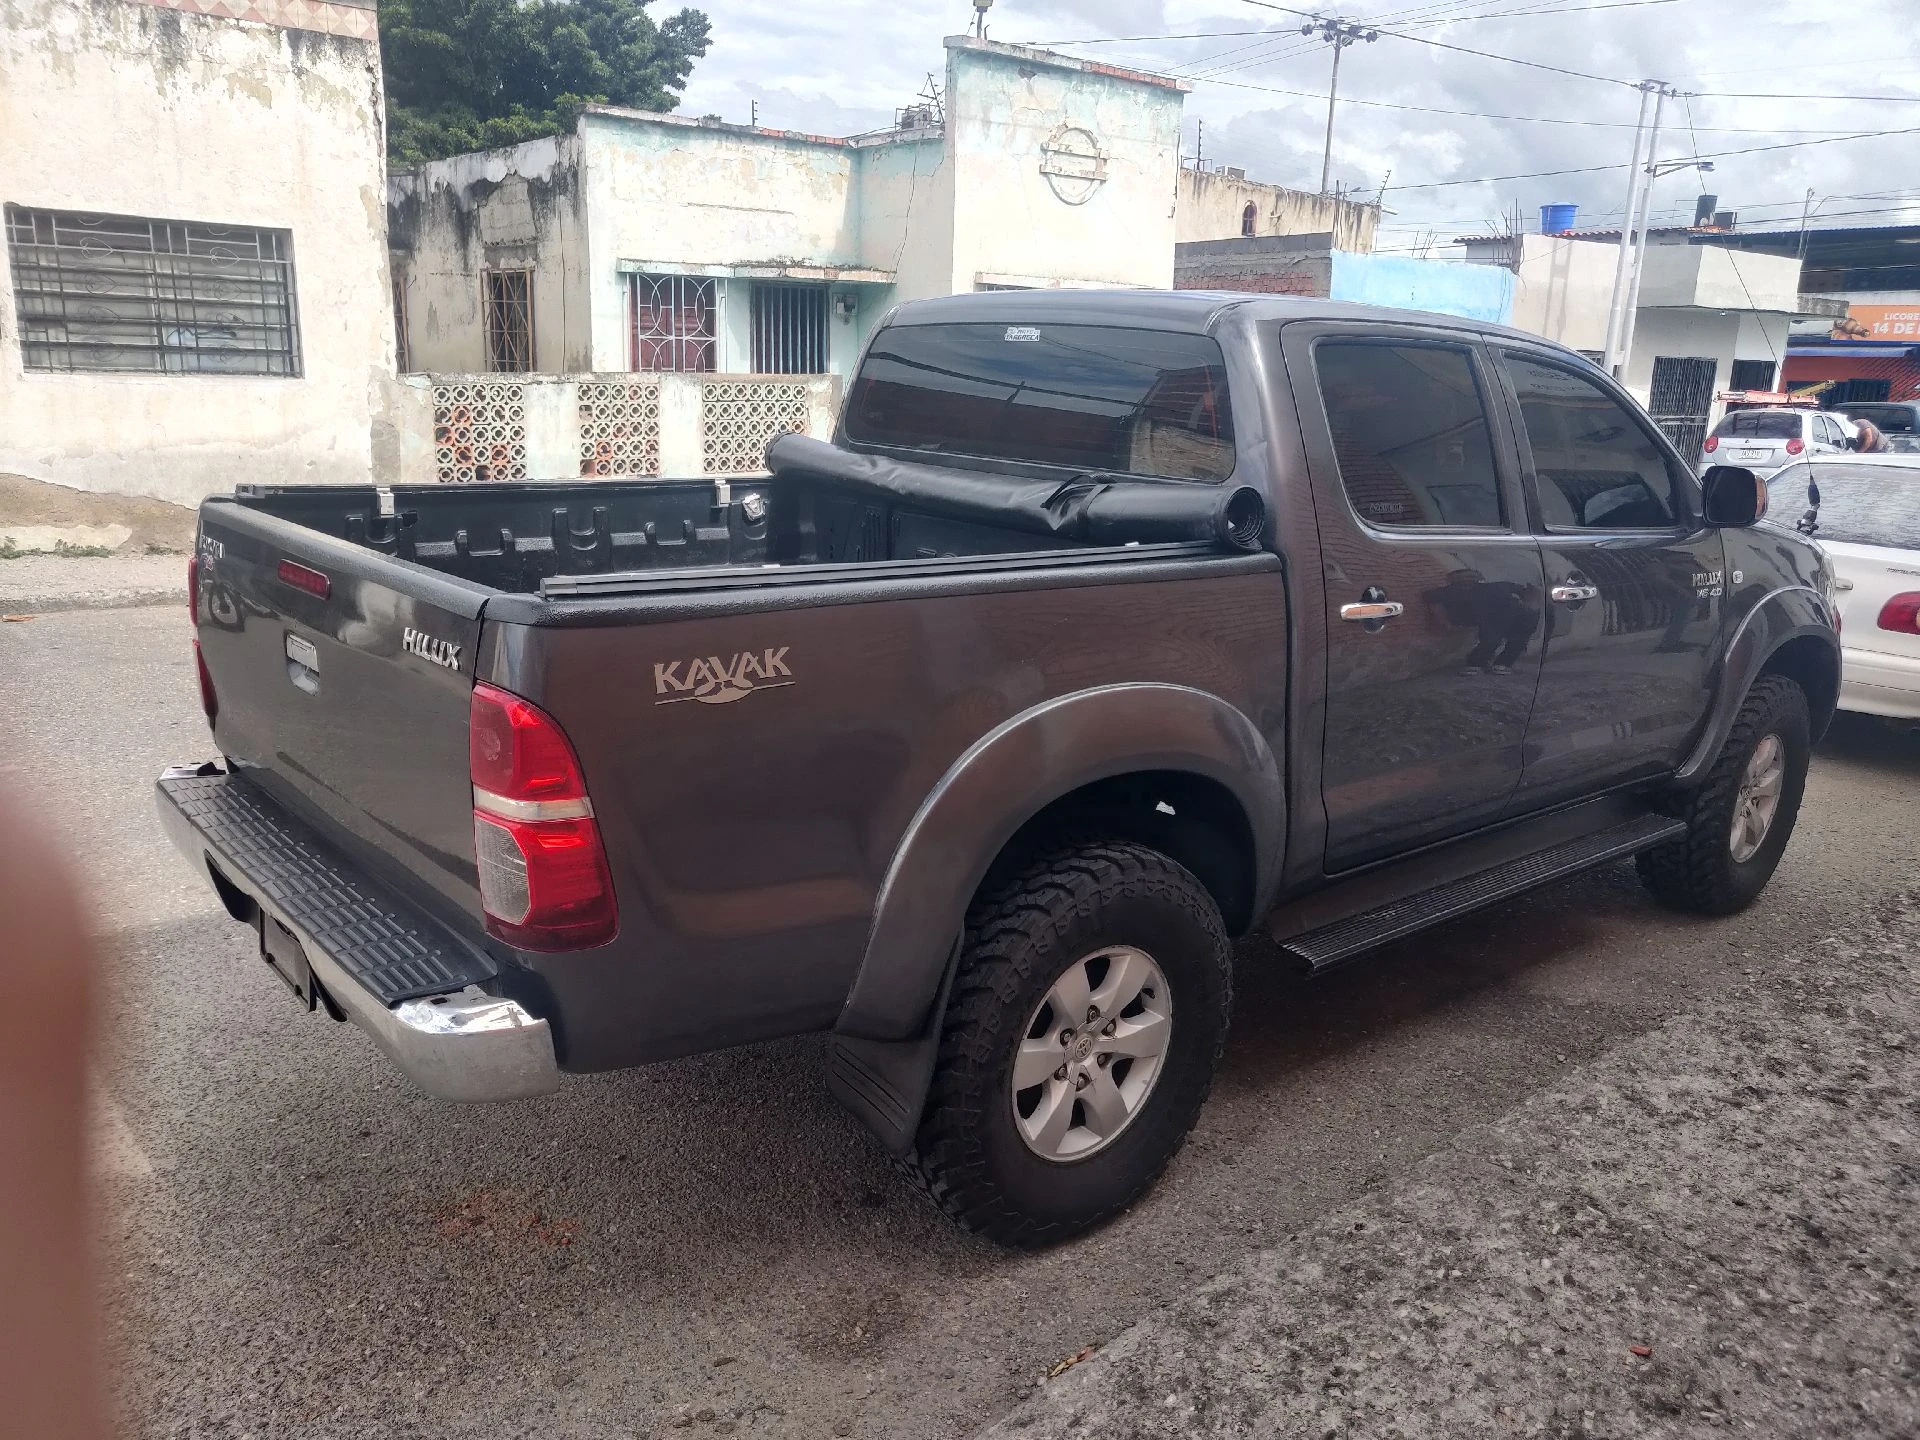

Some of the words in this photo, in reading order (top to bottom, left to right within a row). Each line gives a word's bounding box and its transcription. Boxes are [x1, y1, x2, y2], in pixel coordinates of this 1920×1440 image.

[1873, 322, 1889, 334] 14
[1893, 322, 1915, 335] DE
[402, 627, 461, 671] HILUX
[653, 646, 793, 696] KAVAK
